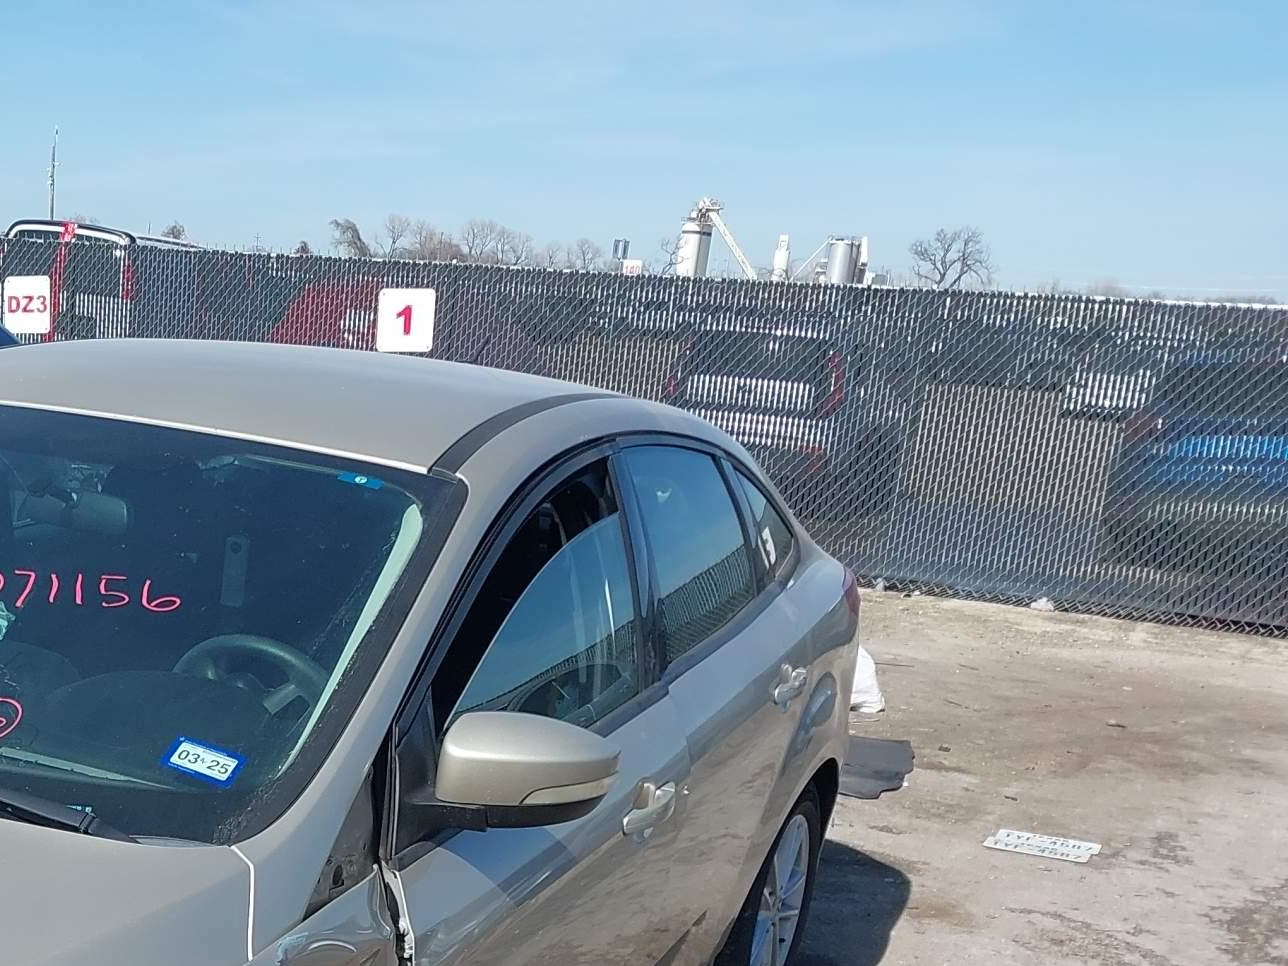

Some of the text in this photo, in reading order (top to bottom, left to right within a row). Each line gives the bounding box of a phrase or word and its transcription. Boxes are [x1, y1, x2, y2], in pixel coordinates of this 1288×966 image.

[7, 295, 48, 313] DZ3
[396, 304, 413, 336] 1
[177, 749, 200, 764] 03
[206, 759, 231, 775] 25
